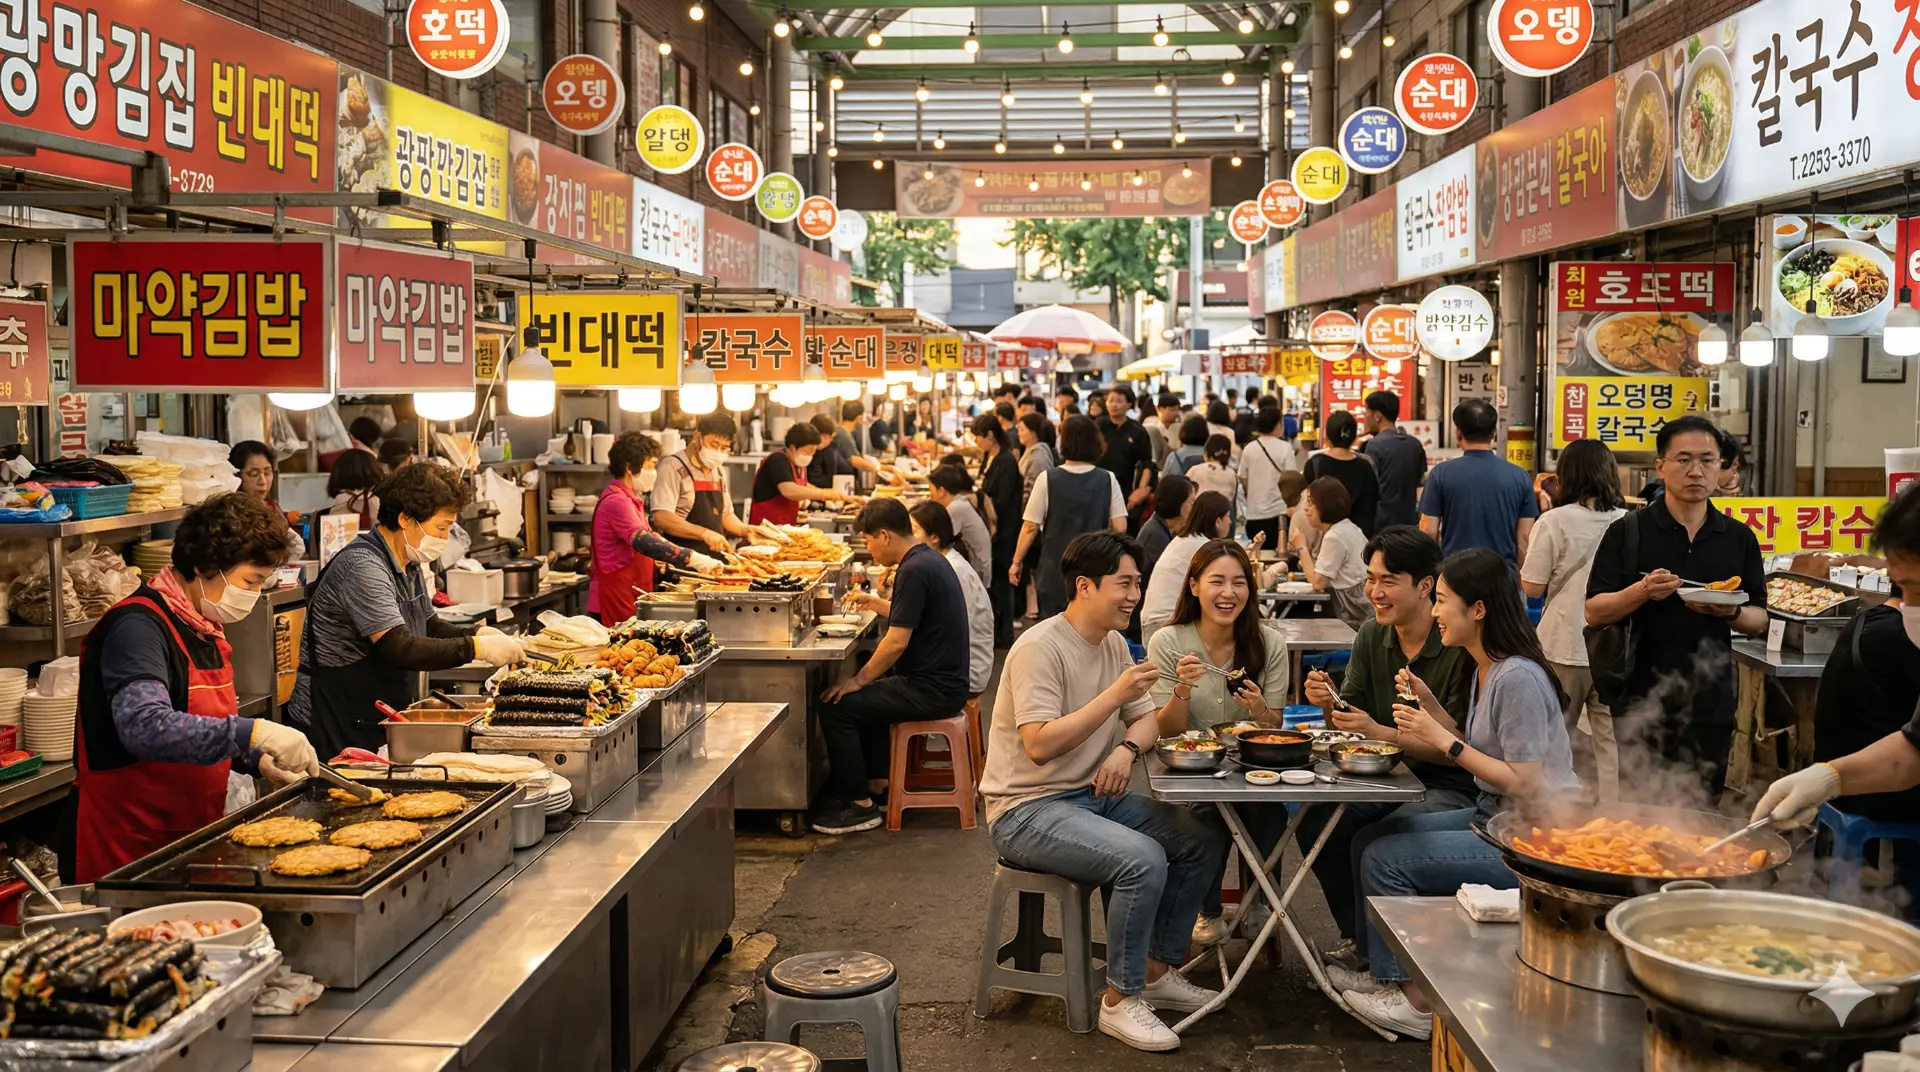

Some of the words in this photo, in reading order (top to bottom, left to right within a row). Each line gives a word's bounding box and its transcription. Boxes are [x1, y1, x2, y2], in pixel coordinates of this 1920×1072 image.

[418, 8, 486, 45] 호떡
[1508, 6, 1580, 46] 오뎅
[1410, 77, 1467, 108] 순대
[1751, 0, 1879, 148] 칼국수
[553, 79, 608, 109] 오뎅
[212, 60, 320, 181] 빈대떡
[643, 128, 691, 152] 알댕
[1350, 127, 1397, 152] 순대
[713, 160, 753, 183] 순대
[1301, 165, 1341, 185] 순대
[1789, 135, 1872, 182] T.2253-3370
[167, 165, 215, 194] -8729
[91, 270, 307, 359] 마약김밥
[346, 274, 467, 365] 마약김밥
[1369, 316, 1415, 343] 순대
[535, 311, 665, 369] 빈대떡
[701, 329, 793, 370] 칼국수
[922, 342, 958, 365] 대떡
[1722, 505, 1782, 553] 잔
